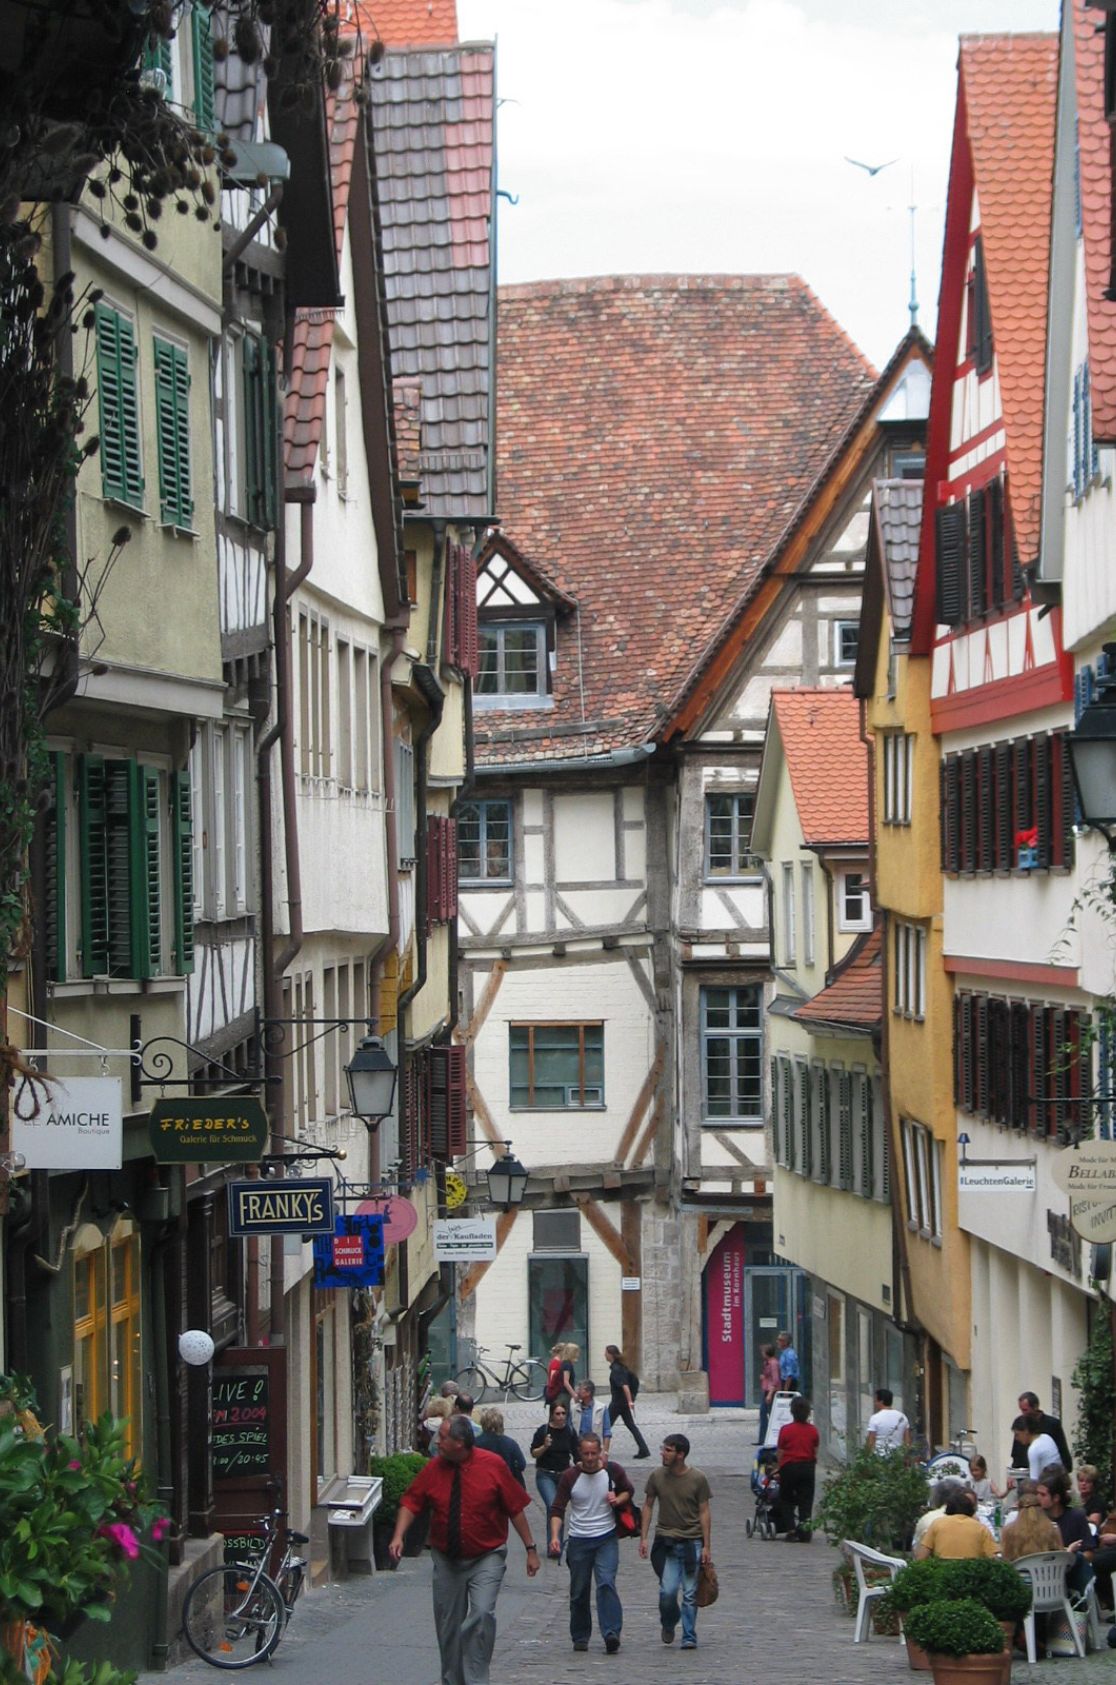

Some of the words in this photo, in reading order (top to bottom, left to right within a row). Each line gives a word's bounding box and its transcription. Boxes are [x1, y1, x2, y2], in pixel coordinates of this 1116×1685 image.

[46, 1113, 110, 1126] AMICHE
[180, 1135, 207, 1144] Galerie
[209, 1135, 220, 1144] für
[222, 1134, 257, 1143] Schmuck
[964, 1176, 1034, 1186] LeuchtenGalerie
[334, 1236, 361, 1245] DIE
[453, 1232, 493, 1240] Kaufladen
[335, 1257, 363, 1265] GALERIE
[721, 1251, 732, 1343] Stadtmuseum
[213, 1381, 248, 1402] IVE
